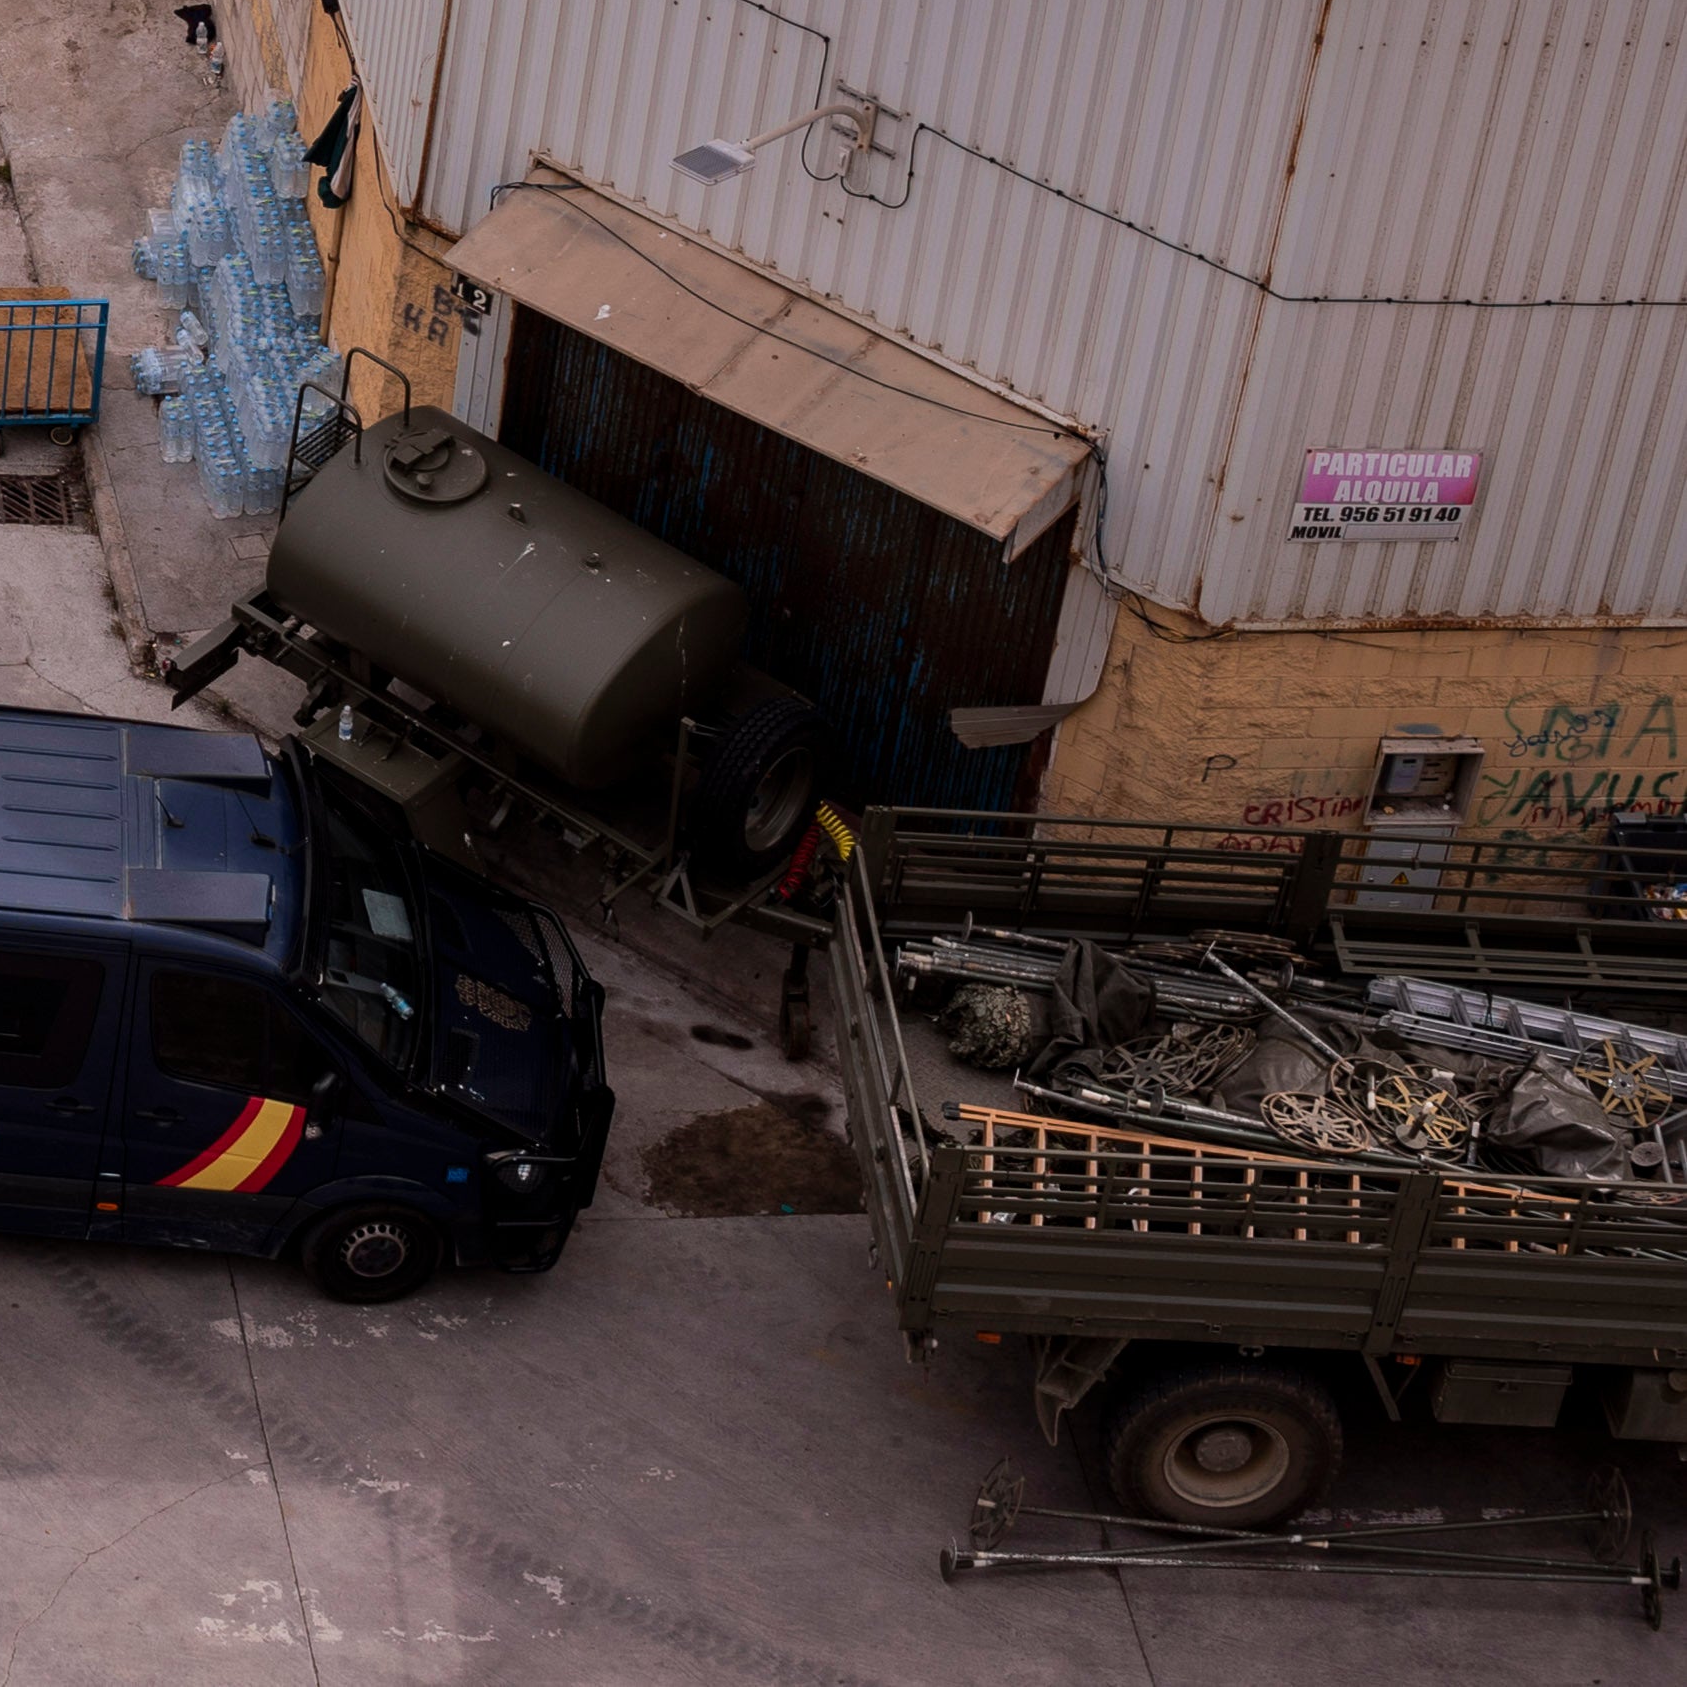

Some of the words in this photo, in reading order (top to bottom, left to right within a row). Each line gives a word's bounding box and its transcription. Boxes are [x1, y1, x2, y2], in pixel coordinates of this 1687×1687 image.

[456, 282, 488, 312] 12
[1312, 452, 1473, 478] PARTICULAR
[1333, 480, 1439, 504] ALQUILA
[1303, 507, 1334, 522] TEL.
[1339, 506, 1379, 522] 956
[1383, 507, 1404, 522] 51
[1408, 508, 1430, 522] 91
[1434, 507, 1461, 522] 40
[1291, 526, 1342, 539] MOVIL
